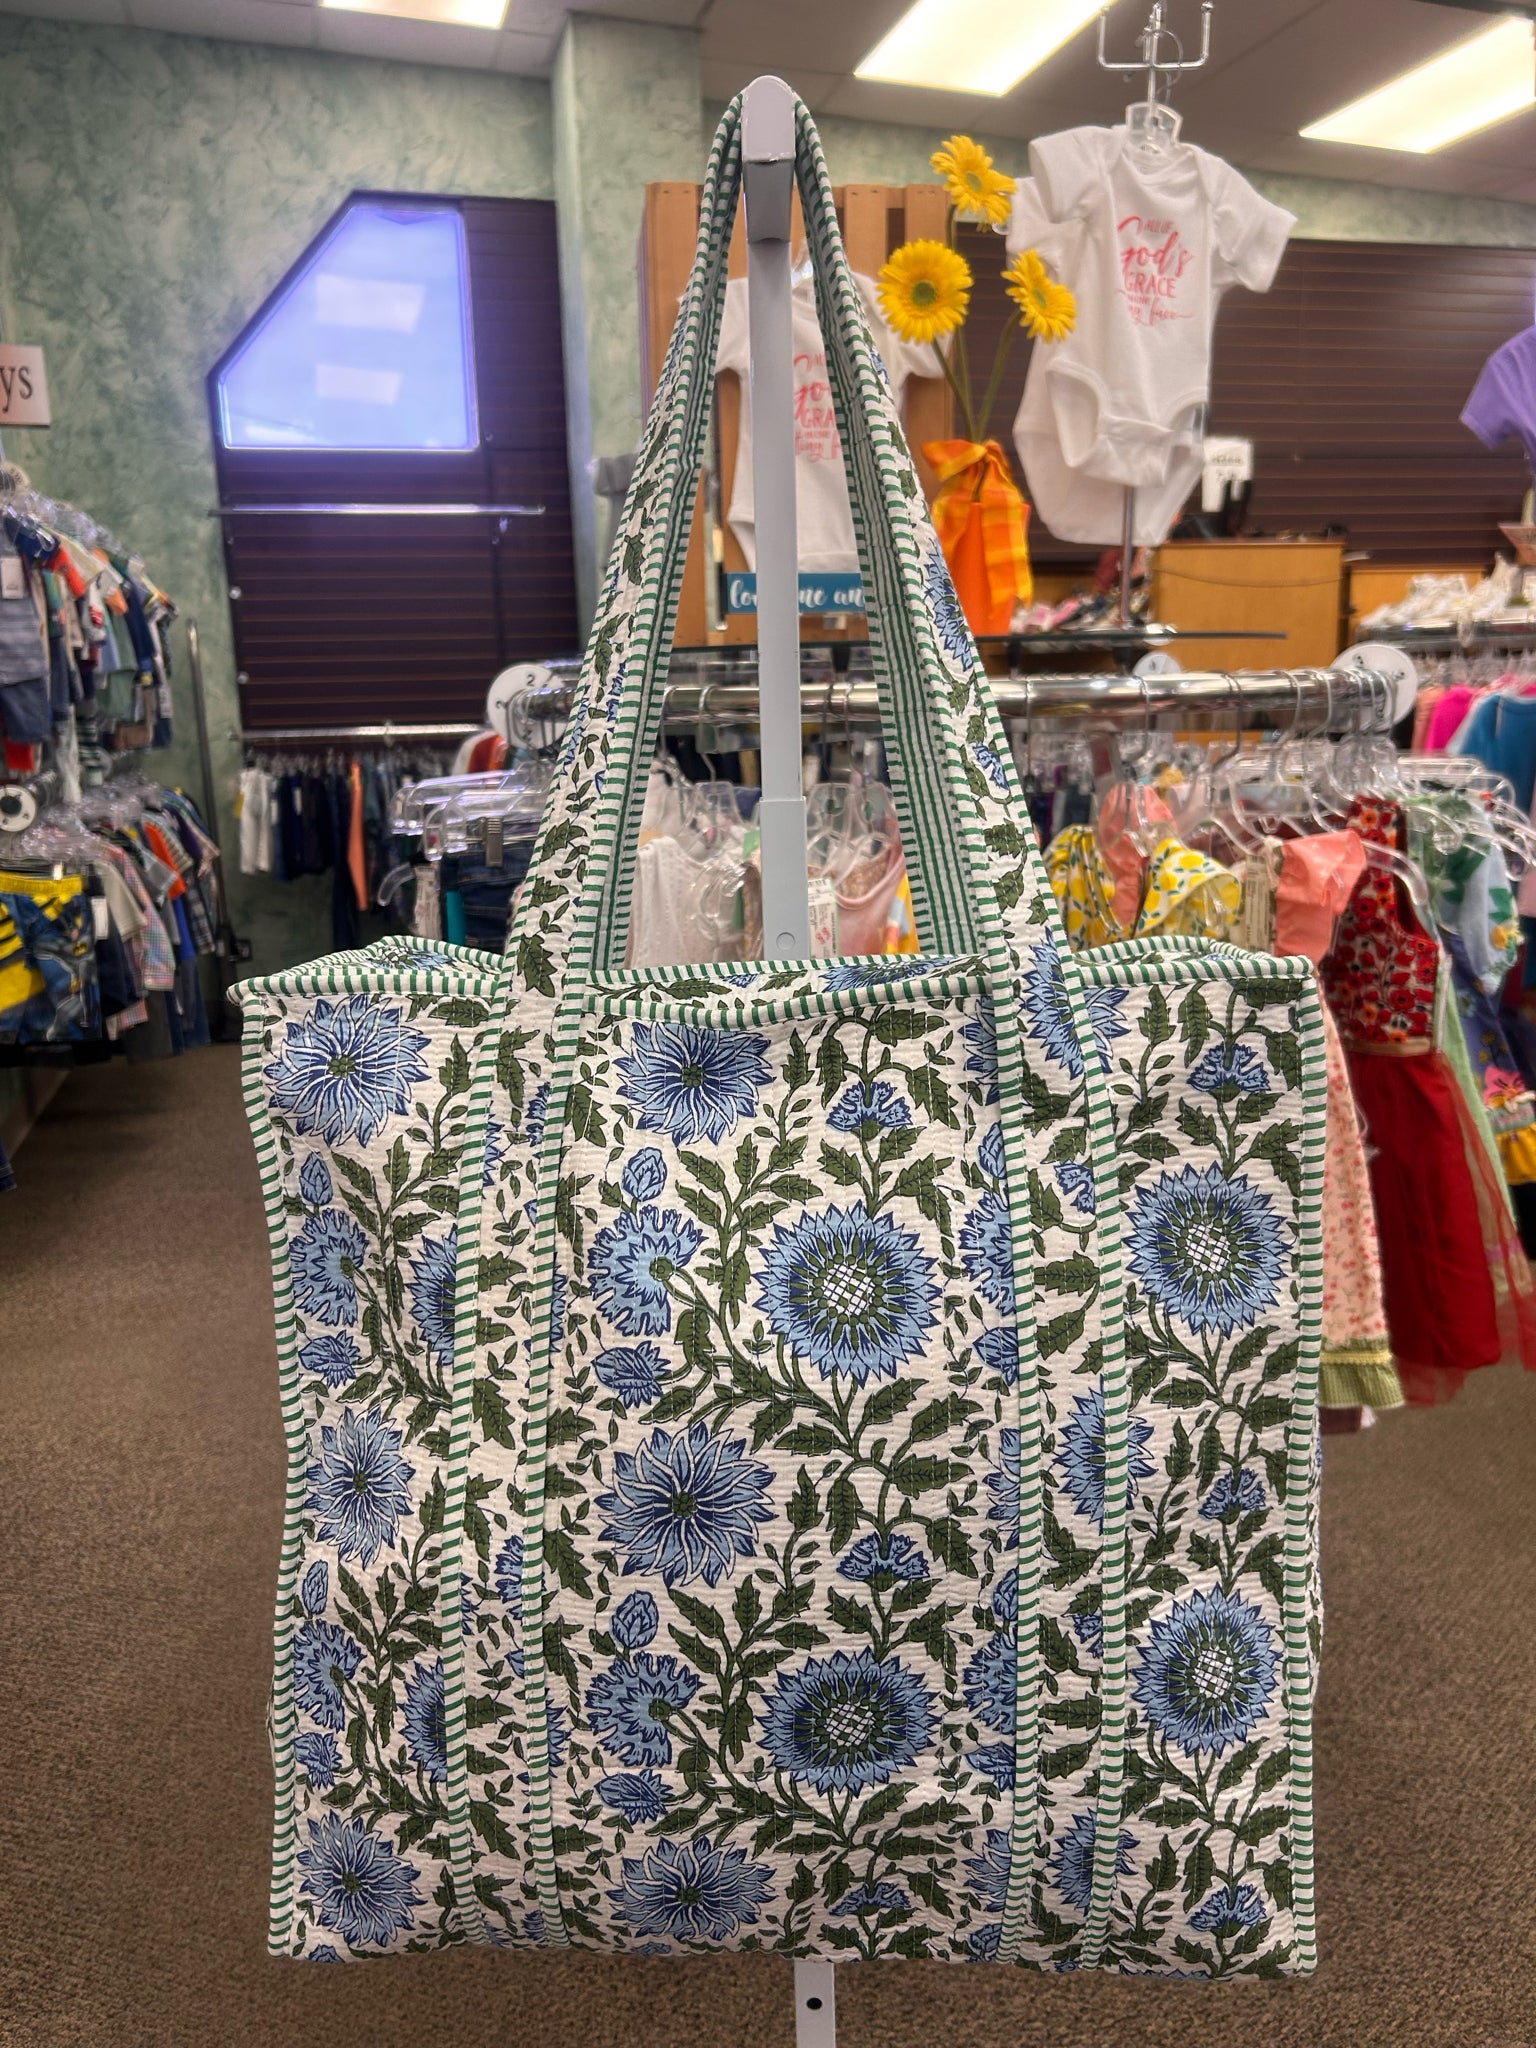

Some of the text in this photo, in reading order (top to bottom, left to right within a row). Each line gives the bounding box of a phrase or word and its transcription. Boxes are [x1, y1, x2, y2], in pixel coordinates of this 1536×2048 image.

[1124, 271, 1177, 298] GRACE
[0, 366, 33, 413] ys
[801, 407, 836, 428] GRA
[526, 673, 536, 687] 2
